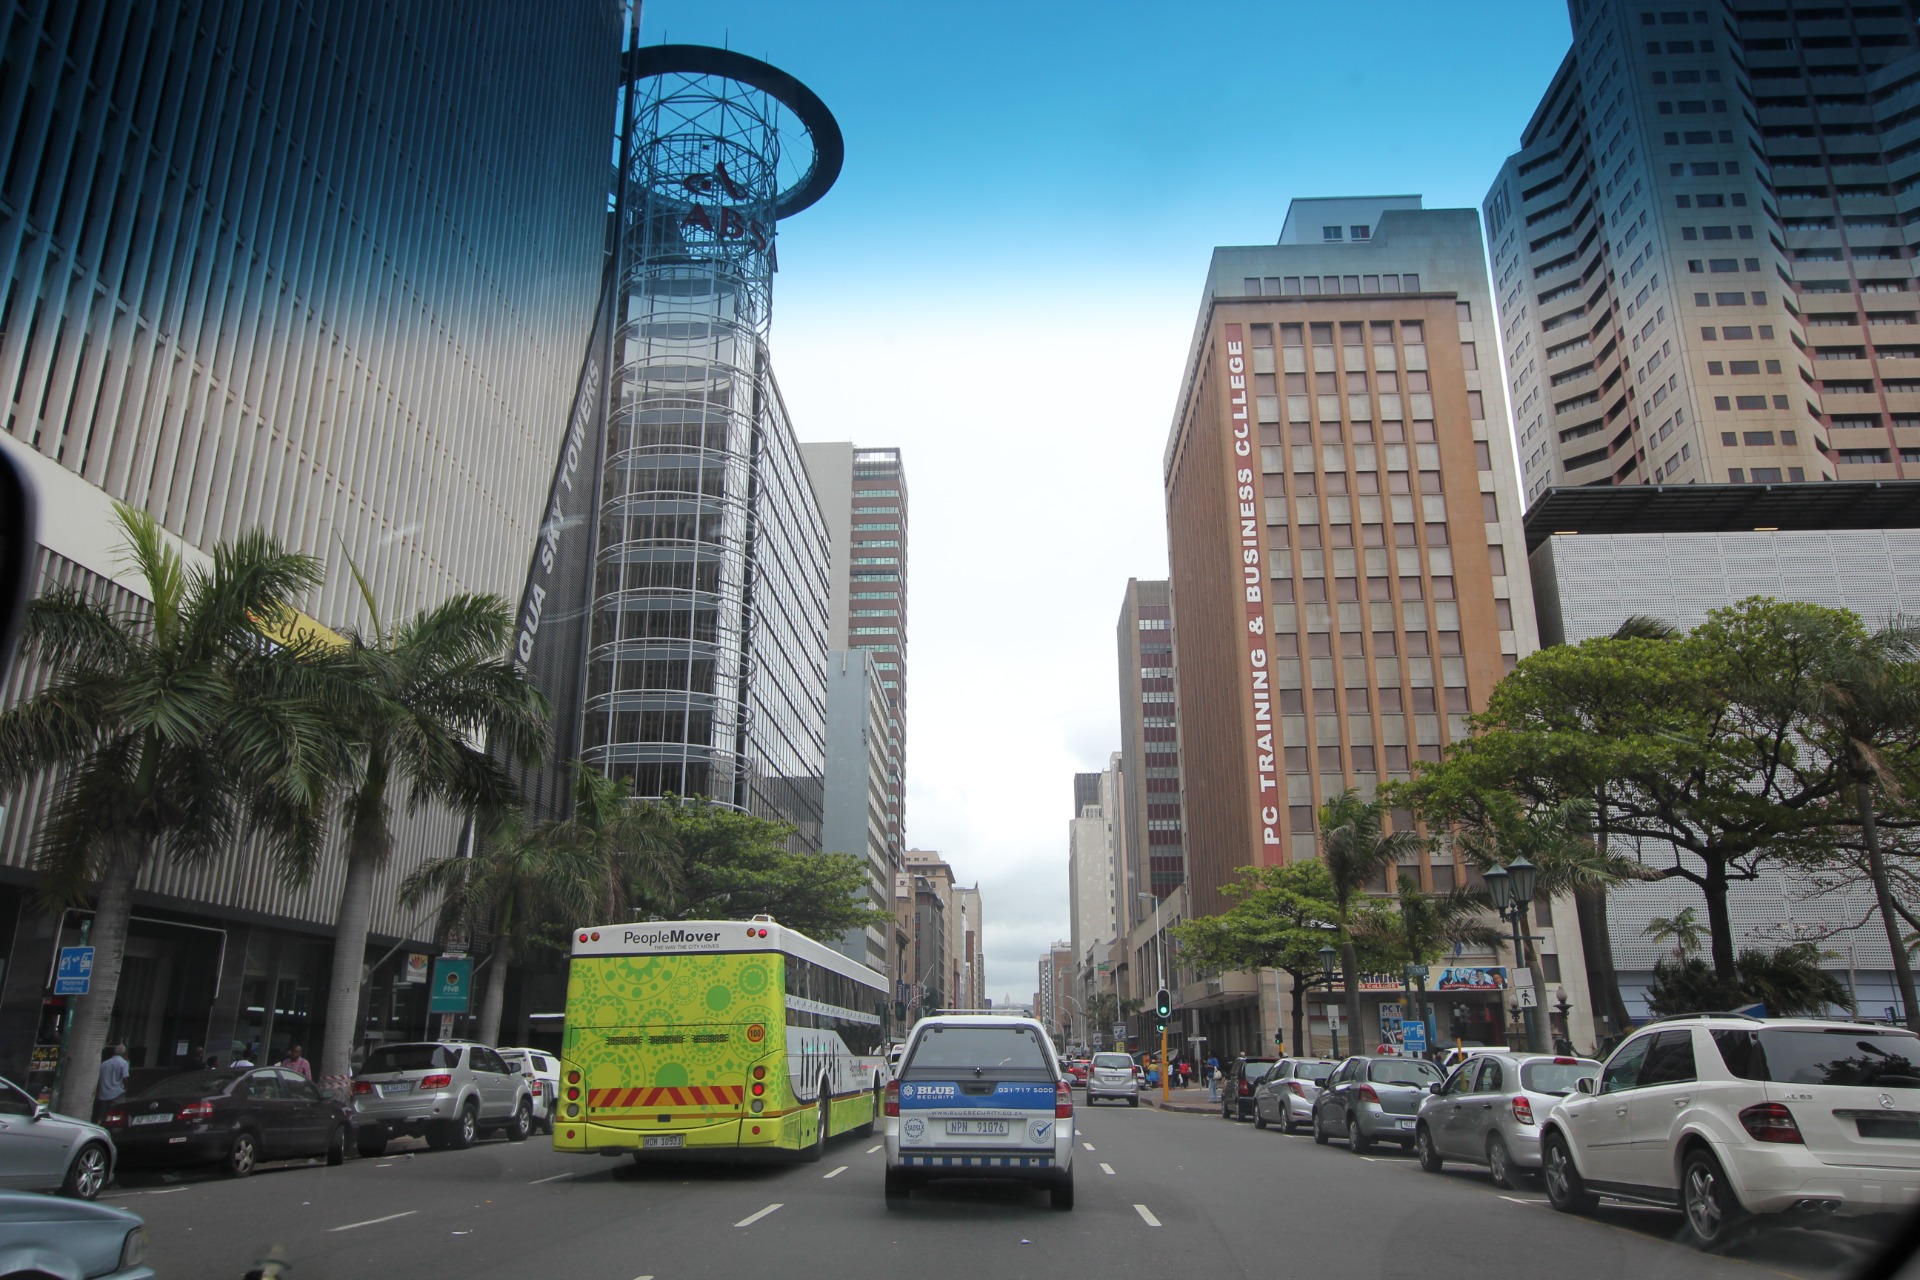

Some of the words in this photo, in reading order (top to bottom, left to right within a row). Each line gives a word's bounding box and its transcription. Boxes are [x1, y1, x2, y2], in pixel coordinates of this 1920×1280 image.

[681, 201, 779, 273] ABSA
[541, 495, 565, 574] SKY
[561, 359, 599, 491] TOWERS
[1238, 467, 1262, 602] BUSINESS
[1249, 616, 1264, 635] &
[1251, 648, 1276, 792] TRAINING
[1262, 805, 1280, 844] PC
[624, 930, 721, 946] PeopleMover
[750, 1029, 761, 1037] 100
[917, 1086, 955, 1095] BLUE
[951, 1121, 968, 1132] NPN
[977, 1121, 1004, 1133] 91076
